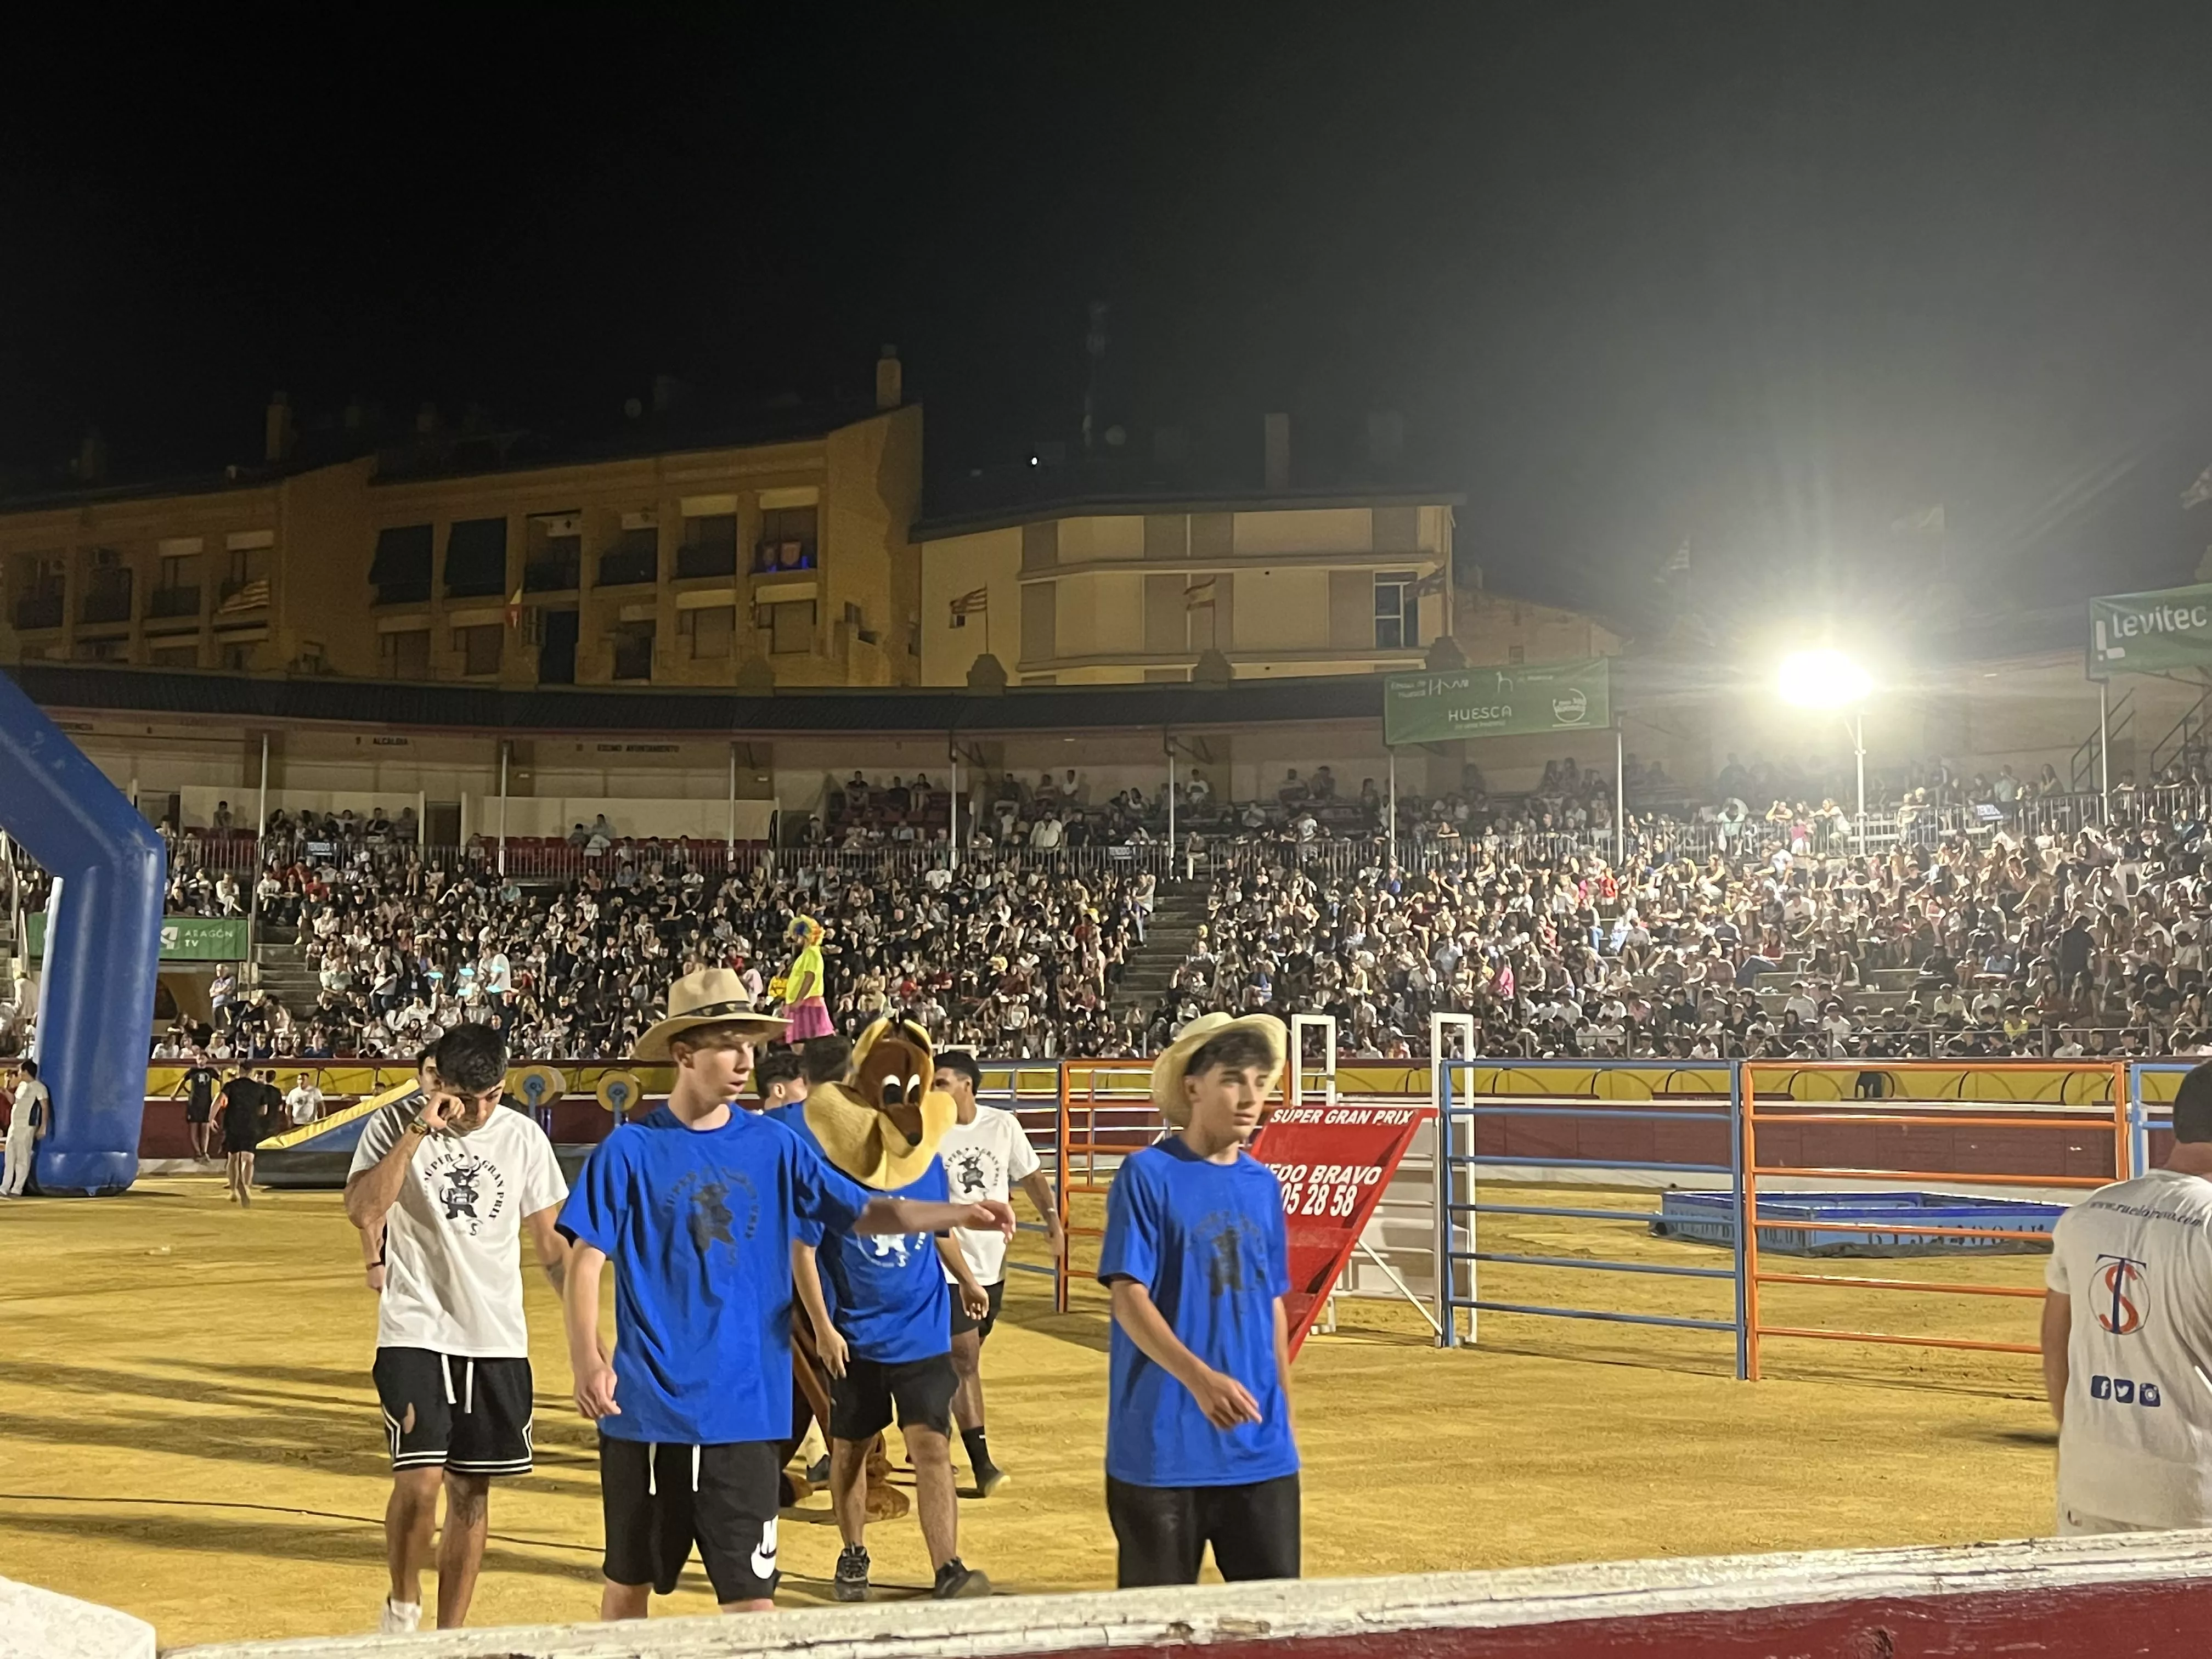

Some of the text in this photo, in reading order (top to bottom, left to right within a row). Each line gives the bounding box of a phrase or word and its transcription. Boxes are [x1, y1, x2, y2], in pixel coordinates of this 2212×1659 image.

[2113, 605, 2207, 639] levitec
[1448, 705, 1512, 722] HUESCA
[185, 939, 199, 947] TV
[1270, 1109, 1414, 1125] SUPER GRAN PRIX
[1265, 1164, 1382, 1185] EDO BRAVO
[1301, 1184, 1329, 1216] 28
[1330, 1185, 1357, 1217] 58
